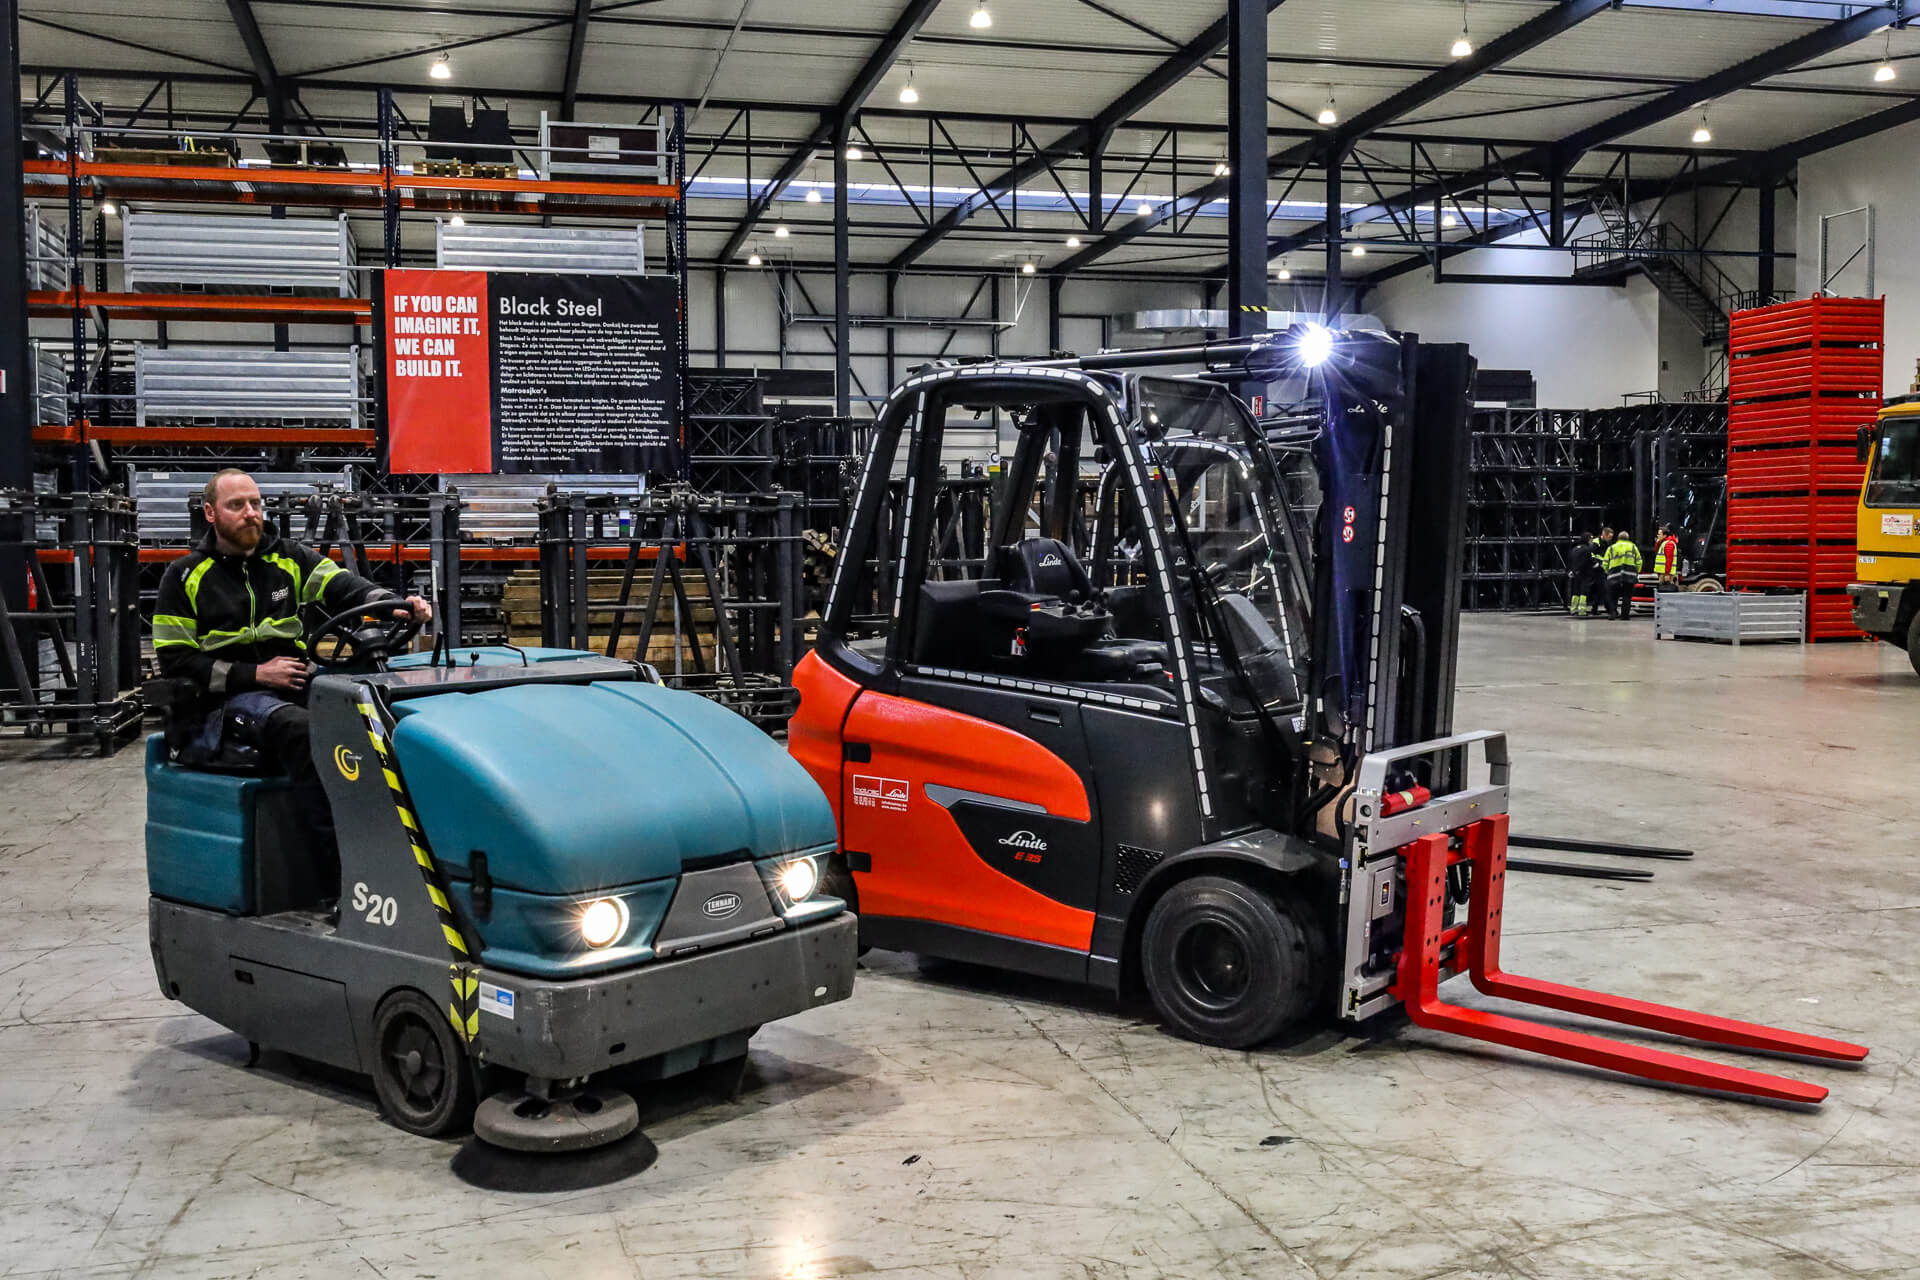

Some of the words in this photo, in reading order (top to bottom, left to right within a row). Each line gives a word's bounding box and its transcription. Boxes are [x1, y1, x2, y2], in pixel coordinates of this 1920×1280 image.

[394, 295, 408, 313] IF
[410, 295, 443, 313] YOU
[445, 296, 478, 314] CAN
[499, 297, 550, 316] Black
[556, 298, 602, 317] Steel
[394, 317, 461, 335] IMAGINE
[463, 318, 481, 336] IT,
[395, 339, 420, 355] WE
[423, 339, 455, 355] CAN
[395, 360, 442, 377] BUILD
[445, 360, 463, 377] IT.
[501, 386, 547, 396] Matroesjka's
[1038, 553, 1063, 568] Linde
[998, 830, 1047, 851] Linde
[1014, 852, 1026, 861] E
[352, 881, 398, 926] S20
[708, 896, 736, 913] TENNANT
